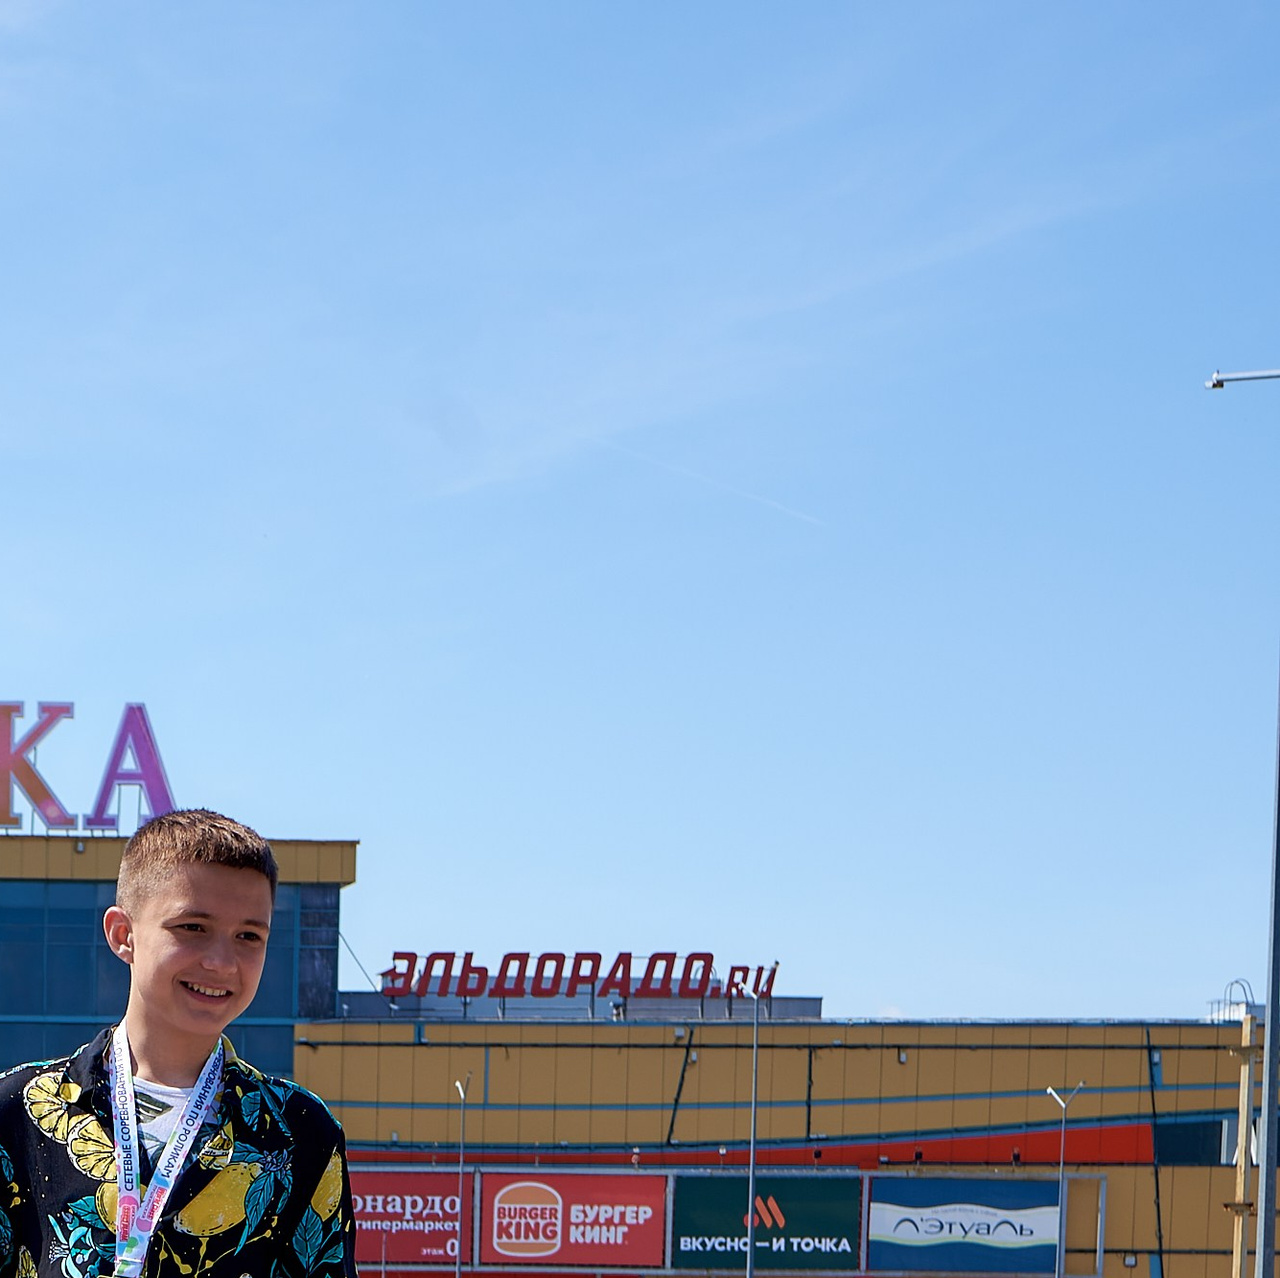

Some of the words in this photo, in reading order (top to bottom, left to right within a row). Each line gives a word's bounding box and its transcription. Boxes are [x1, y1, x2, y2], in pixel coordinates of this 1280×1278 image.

[186, 1111, 199, 1128] ПО
[161, 1128, 192, 1179] РОЛИКАМ
[121, 1144, 134, 1192] СЕТЕВЫЕ
[497, 1205, 558, 1221] BURGER
[570, 1204, 653, 1225] БУРГЕР
[496, 1221, 558, 1241] KING
[570, 1225, 629, 1244] КИНГ
[790, 1237, 851, 1252] ТОЧКА
